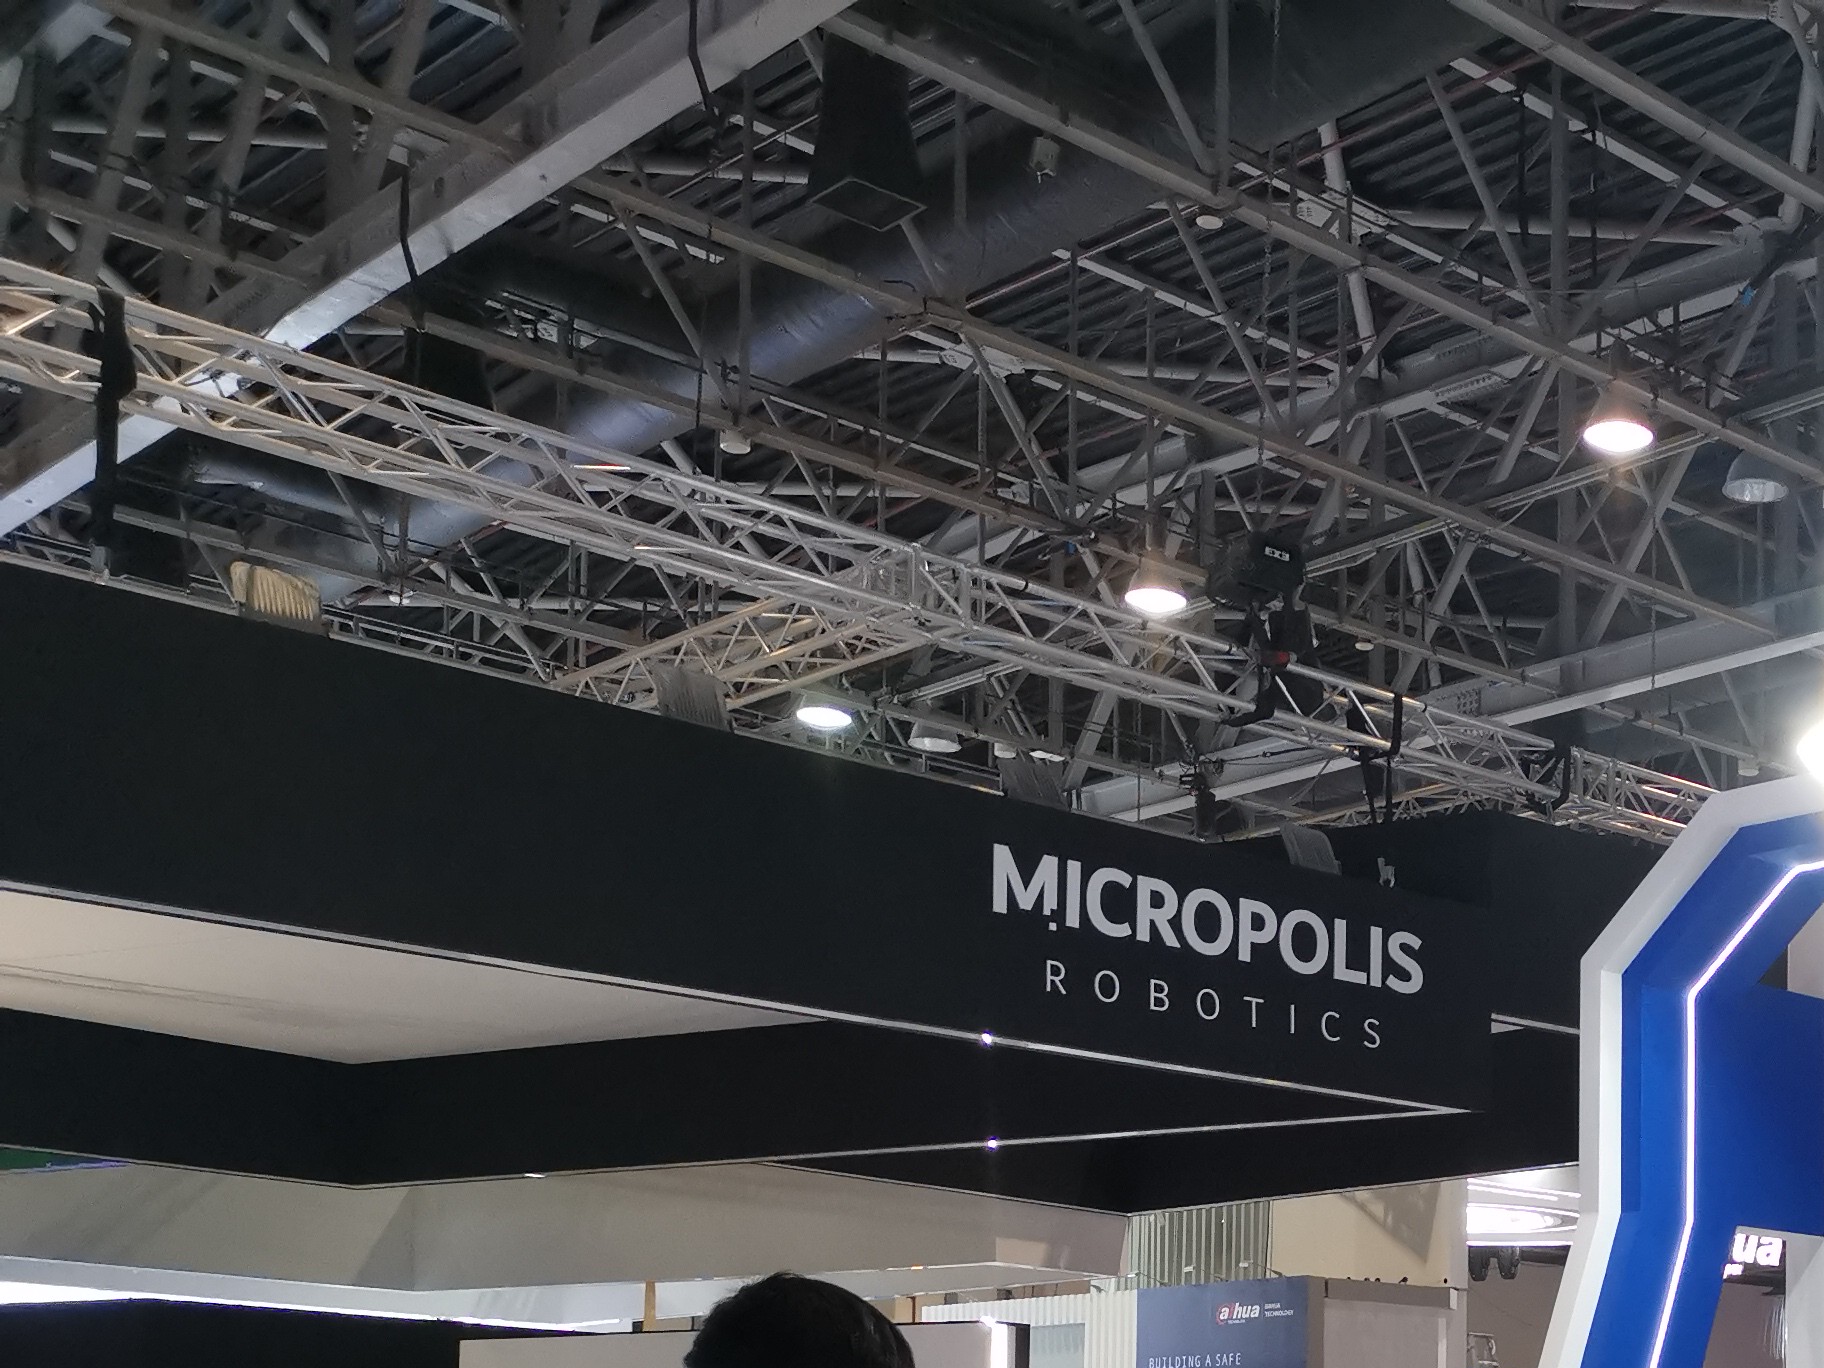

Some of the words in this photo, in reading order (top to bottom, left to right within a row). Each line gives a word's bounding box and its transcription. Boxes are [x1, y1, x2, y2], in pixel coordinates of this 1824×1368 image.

[992, 843, 1424, 994] MICROPOLIS
[1045, 959, 1382, 1049] ROBOTICS
[1205, 1354, 1212, 1367] A
[1215, 1353, 1242, 1366] SAFE
